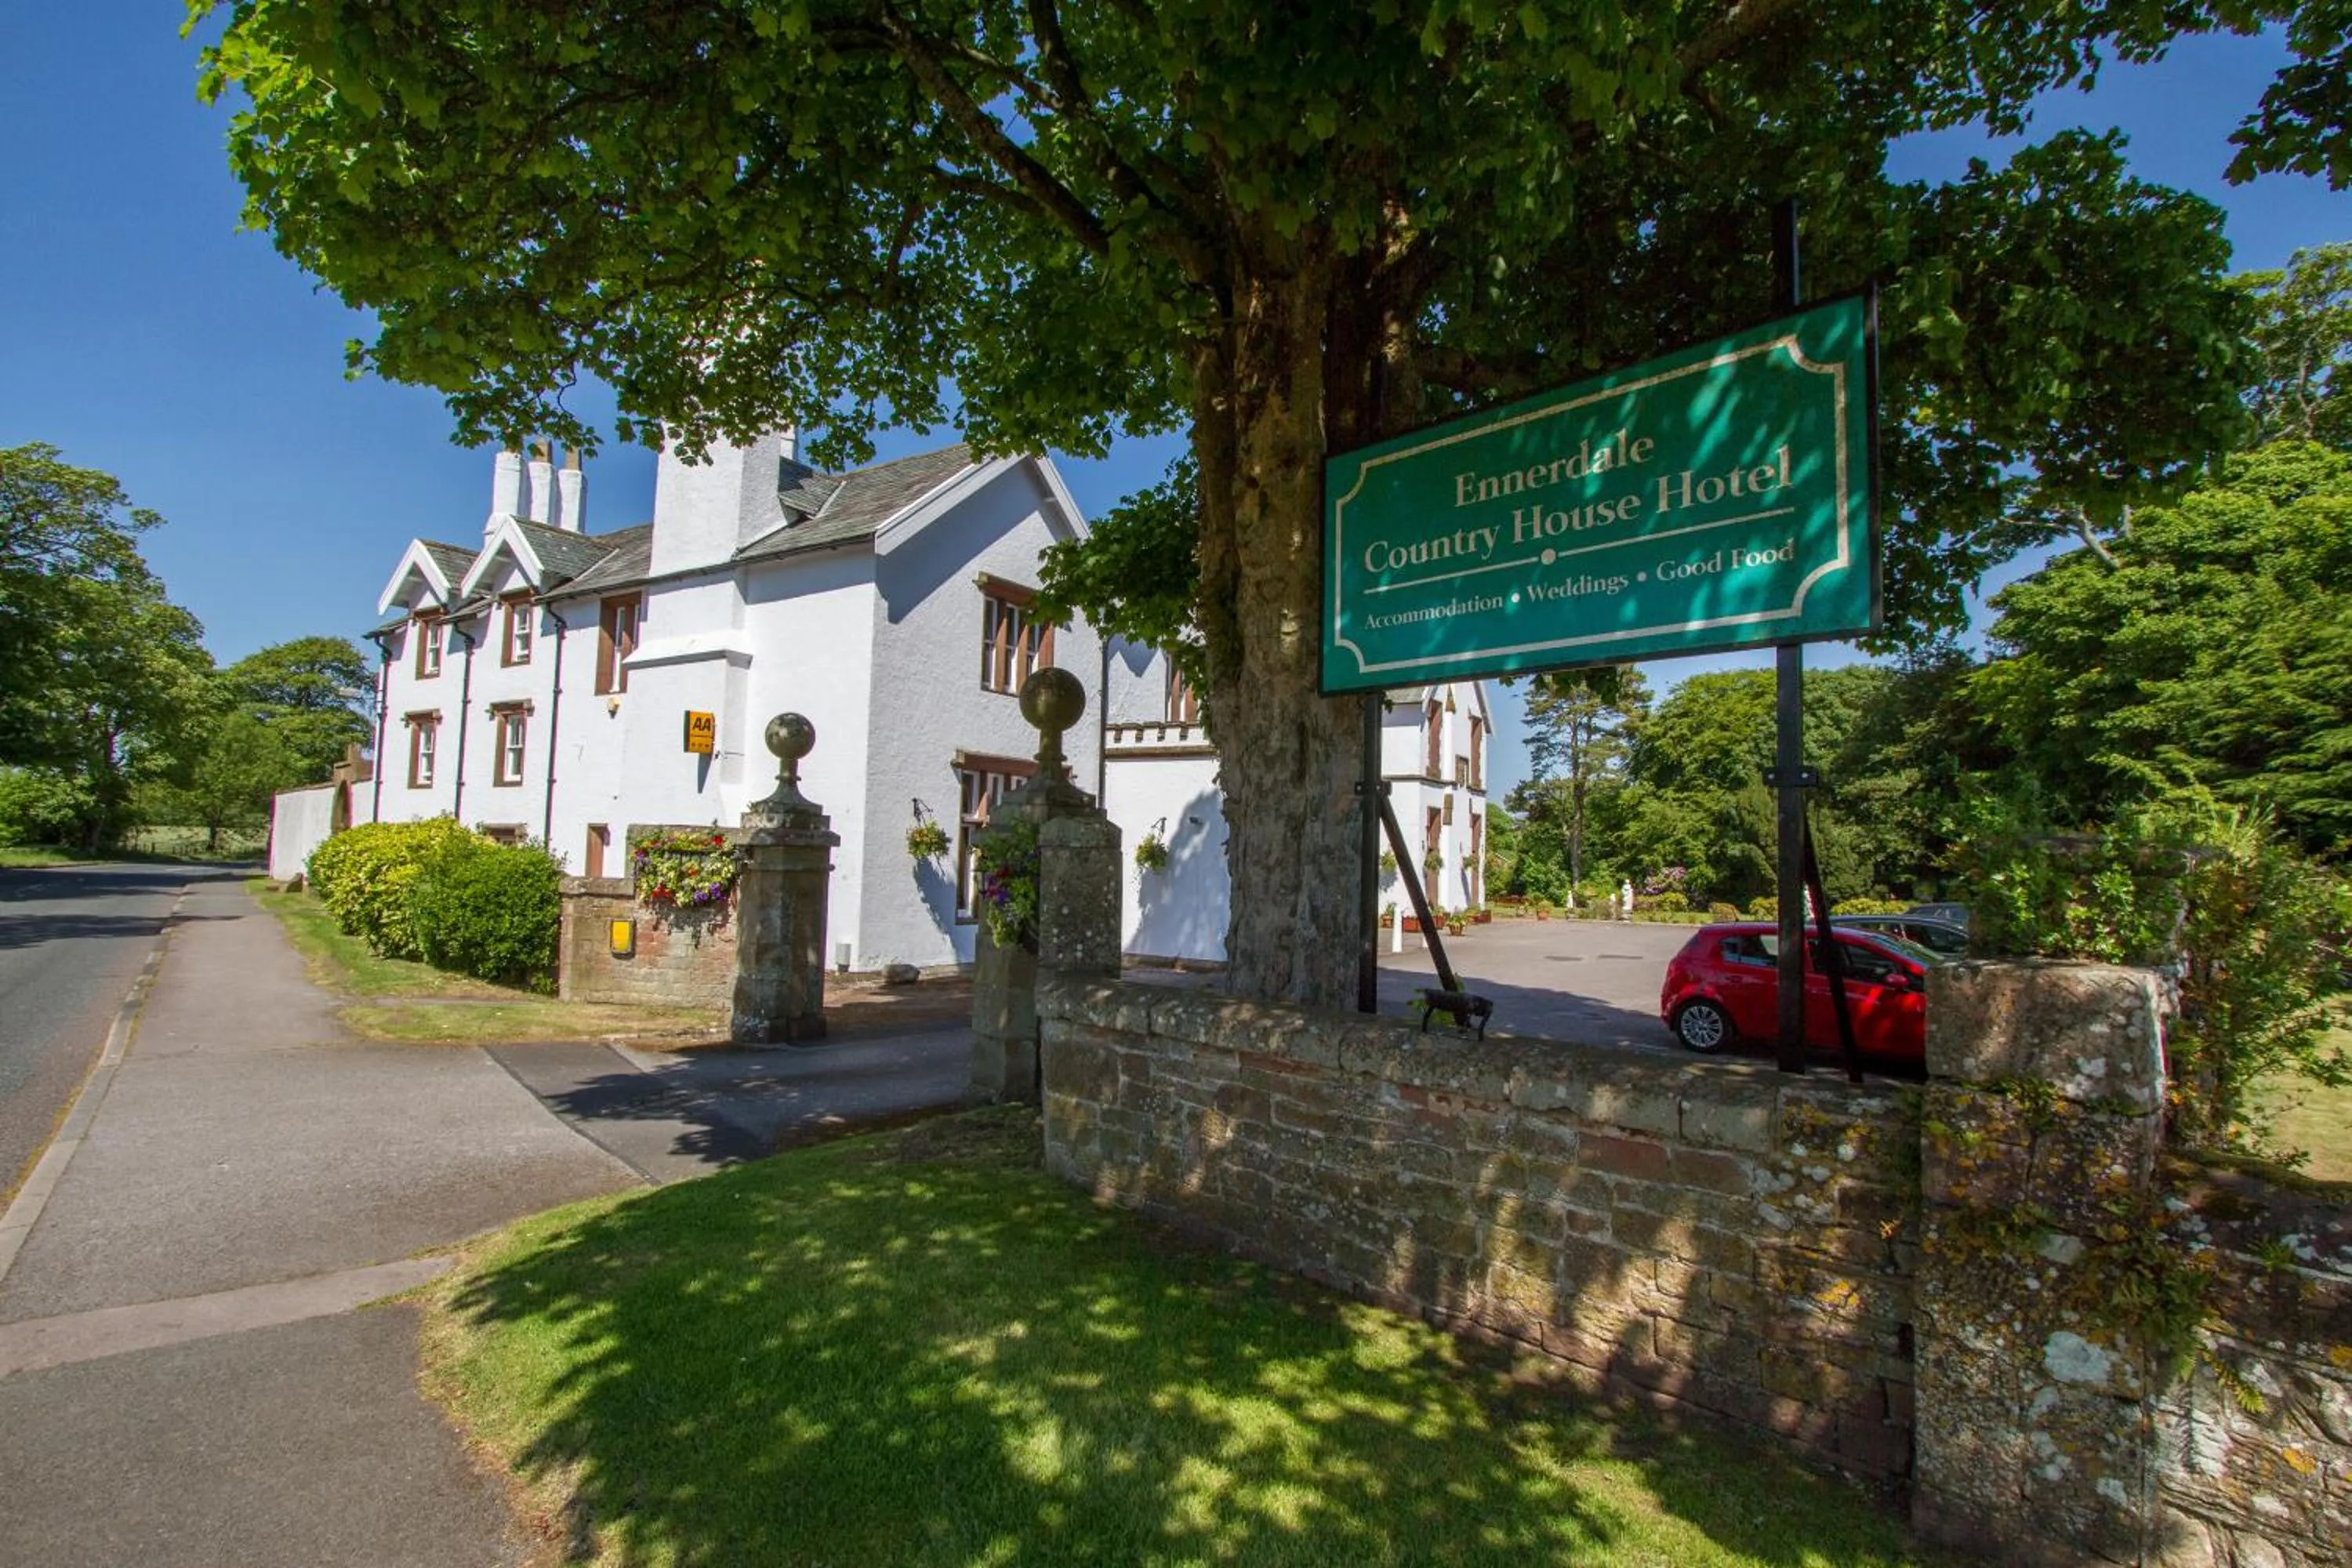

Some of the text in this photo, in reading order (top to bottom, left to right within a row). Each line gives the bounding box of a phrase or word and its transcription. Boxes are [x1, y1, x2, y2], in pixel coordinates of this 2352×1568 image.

[1364, 443, 1794, 573] Country House Hotel
[1455, 427, 1653, 507] Ennerdale
[1365, 537, 1795, 630] Accommodation Weddings Good Food
[692, 717, 711, 731] AA
